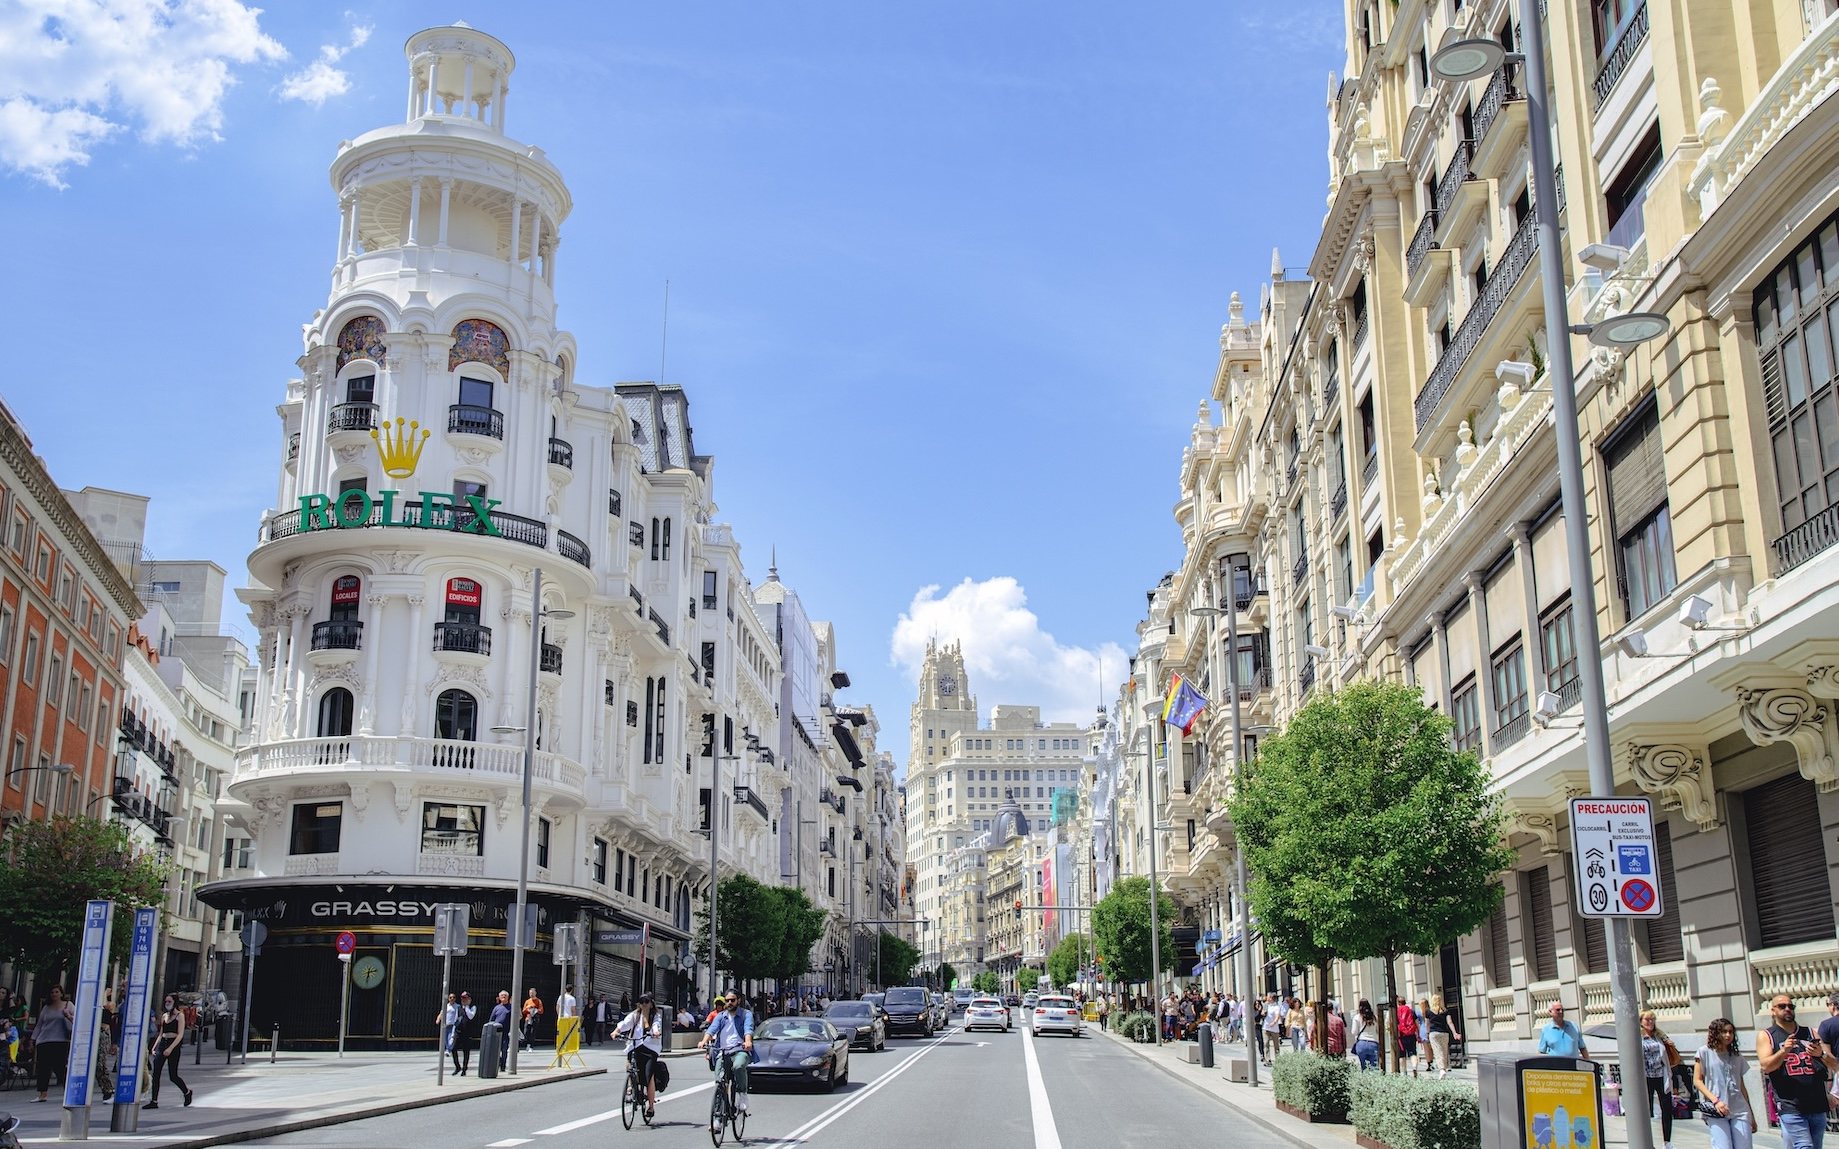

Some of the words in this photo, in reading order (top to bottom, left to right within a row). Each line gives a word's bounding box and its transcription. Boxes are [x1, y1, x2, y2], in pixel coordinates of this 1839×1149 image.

[297, 488, 502, 536] ROLEX
[336, 592, 358, 600] LOCALES
[449, 593, 477, 603] EDIFICIOS
[1577, 802, 1646, 814] PRECAUCIÓN
[1592, 890, 1604, 905] 30
[311, 901, 438, 917] GRASSY
[1783, 1051, 1815, 1077] 23
[1526, 1072, 1552, 1080] Deposita
